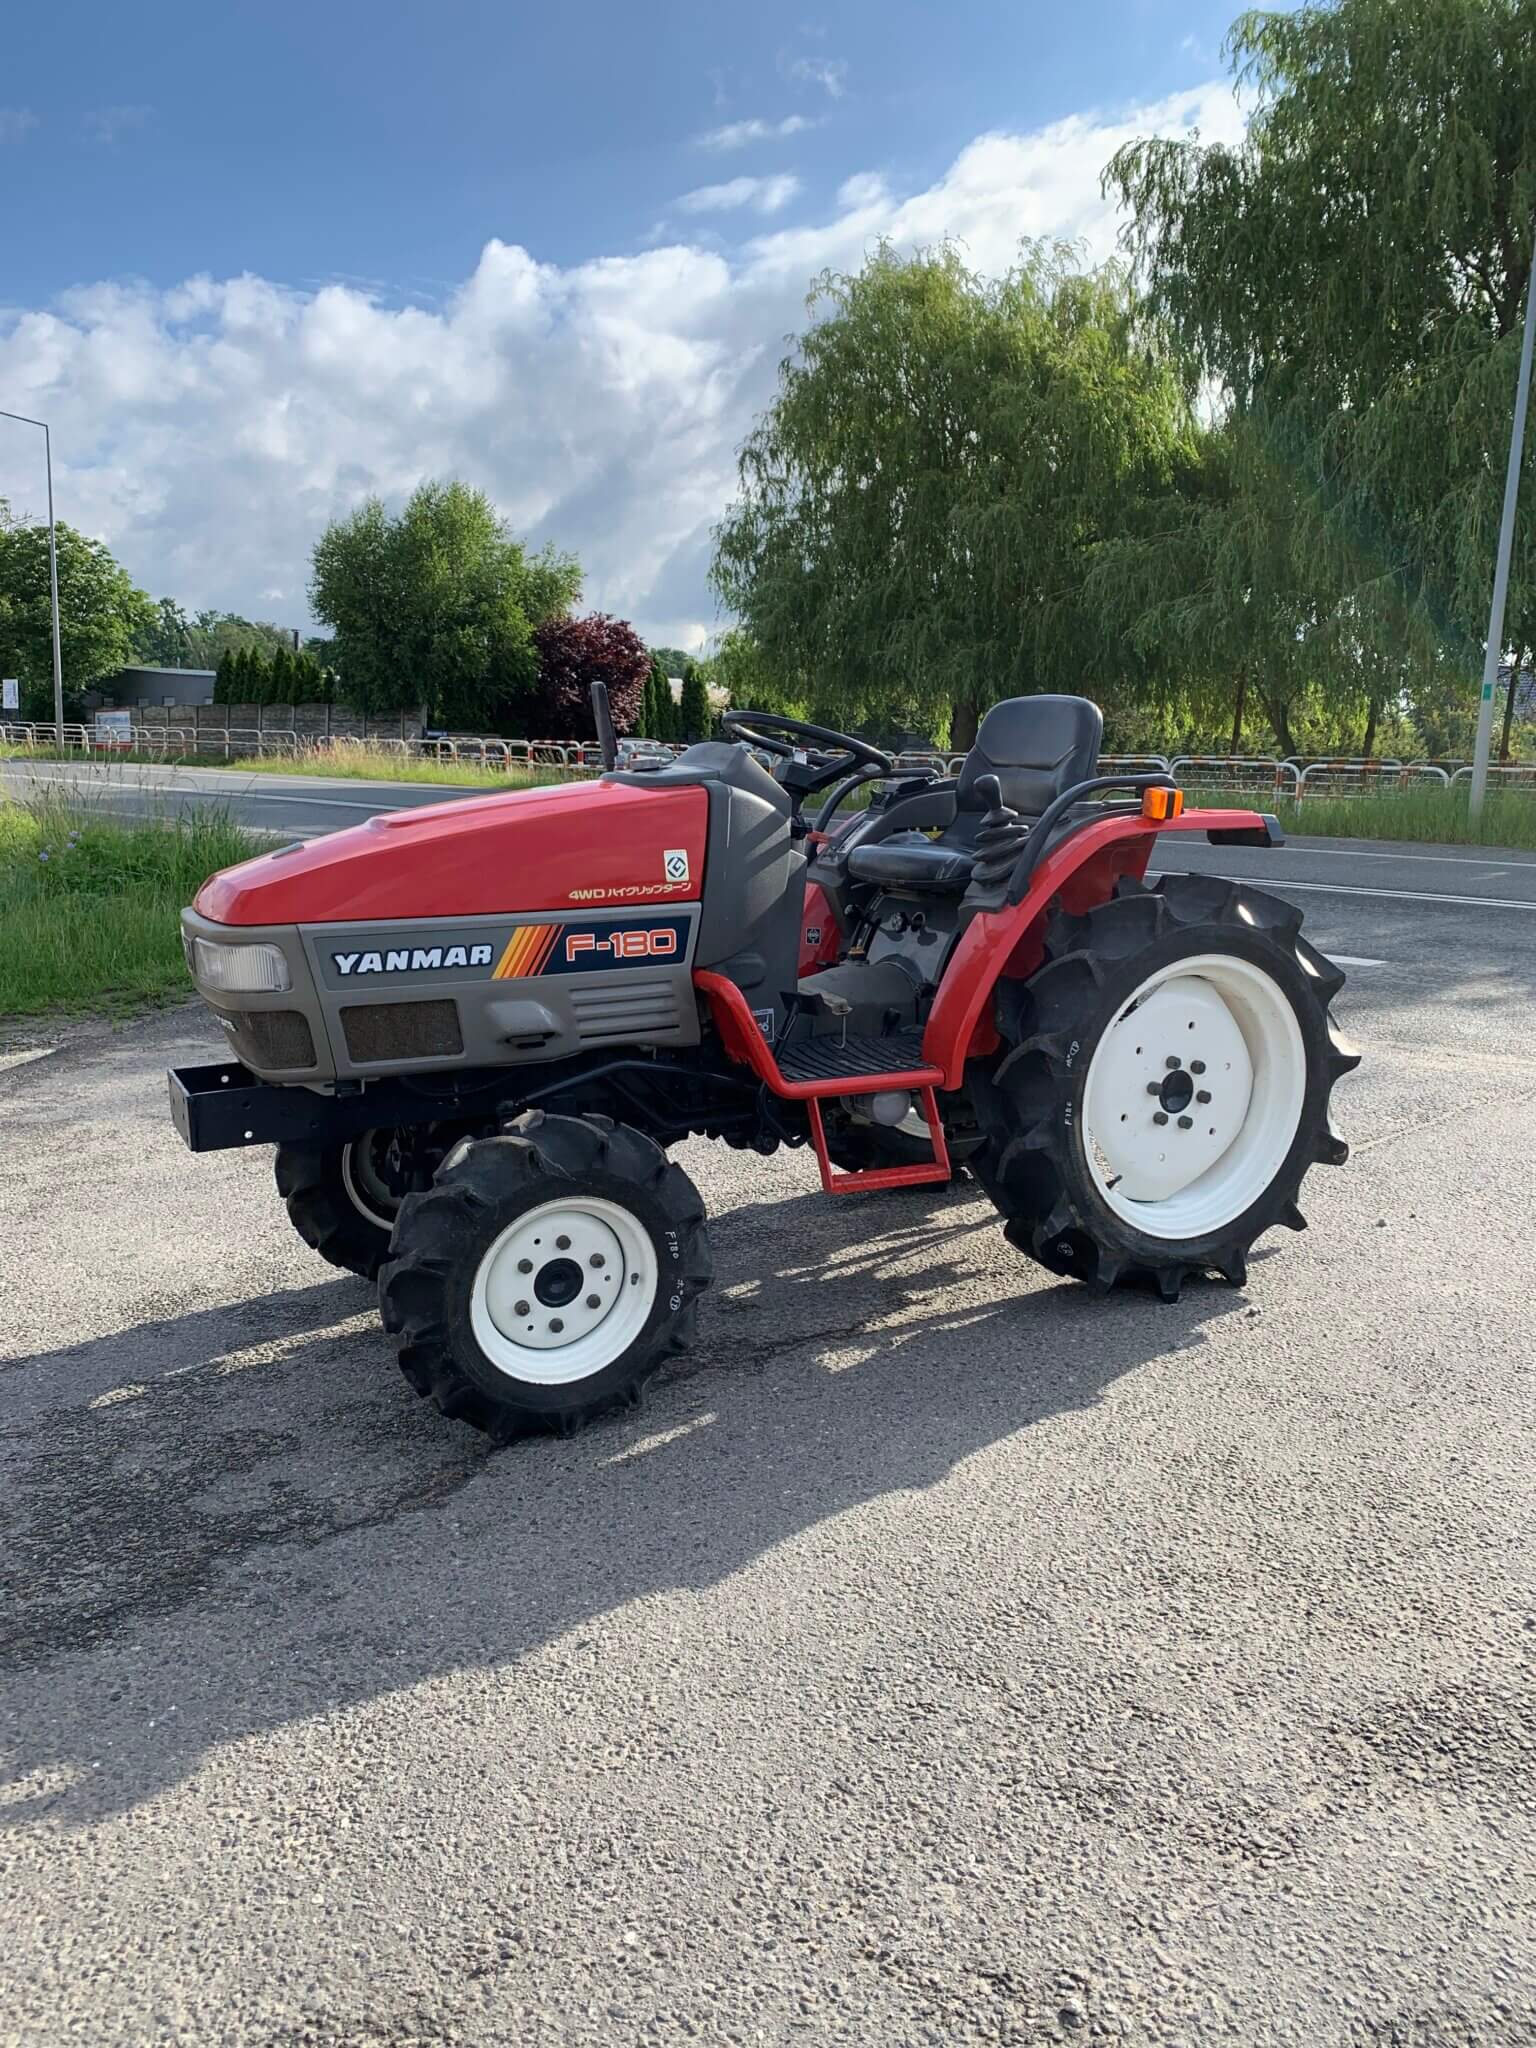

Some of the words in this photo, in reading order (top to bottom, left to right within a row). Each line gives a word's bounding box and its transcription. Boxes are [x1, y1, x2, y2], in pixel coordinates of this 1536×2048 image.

[568, 888, 606, 900] 4WD
[566, 928, 677, 961] F-180
[334, 944, 493, 975] YANMAR
[664, 1231, 680, 1259] F180
